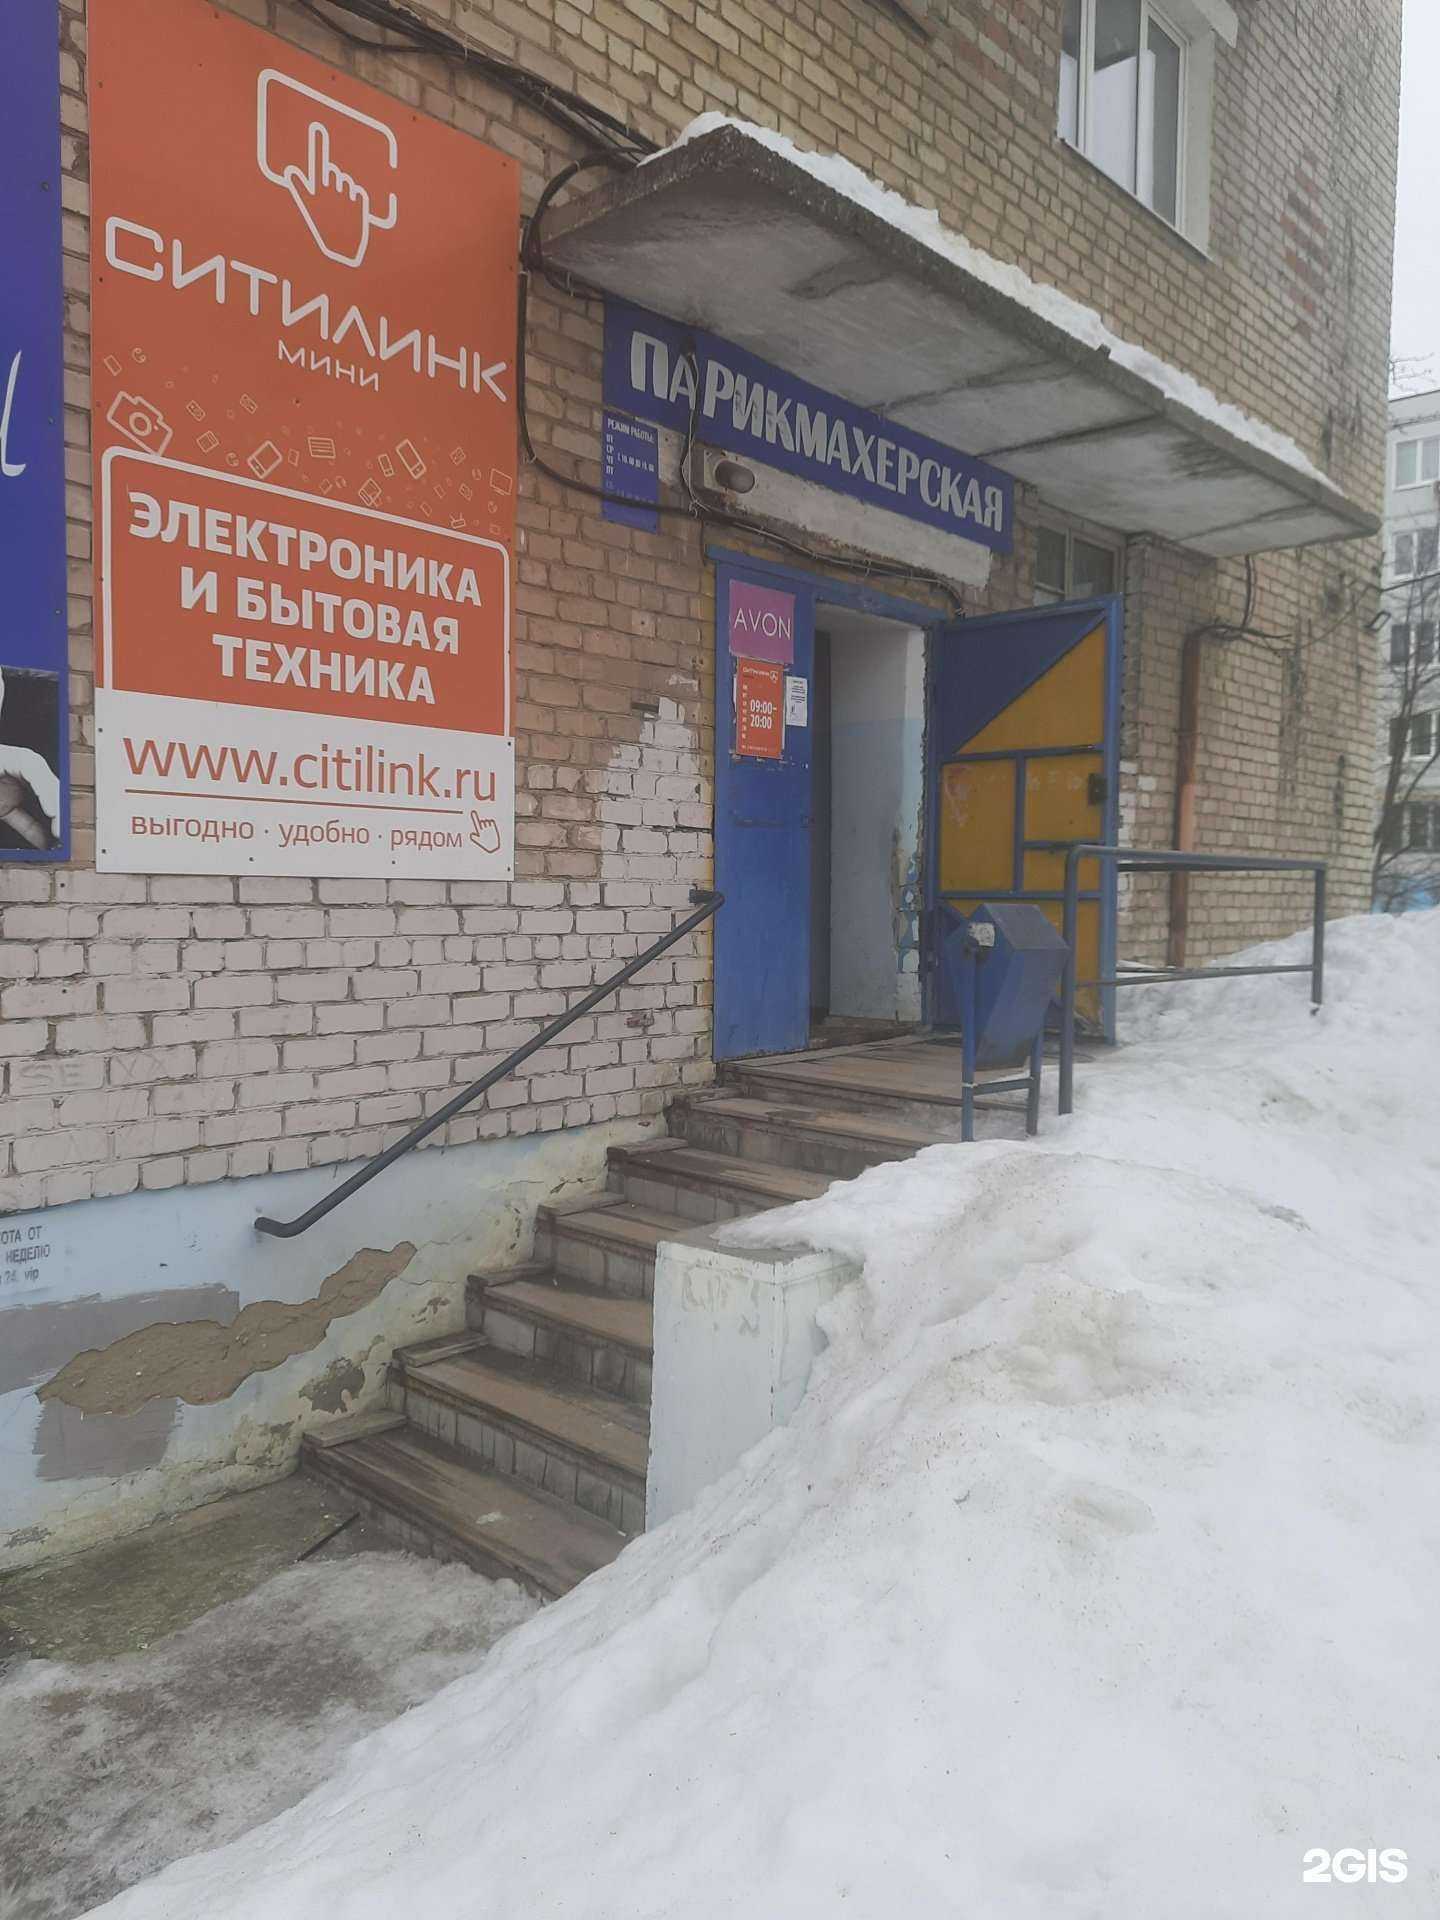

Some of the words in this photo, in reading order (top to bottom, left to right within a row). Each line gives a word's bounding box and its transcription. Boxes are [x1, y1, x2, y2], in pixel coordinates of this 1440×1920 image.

[105, 216, 508, 403] СИТИЛИНК
[629, 329, 1004, 533] ПАРИКМАХЕРСКАЯ
[128, 491, 482, 607] ЭЛЕКТРОНИКА
[180, 567, 218, 614] И
[236, 576, 459, 655] БЫТОВАЯ
[734, 608, 791, 640] AVON
[212, 633, 436, 705] ТЕХНИКА
[750, 714, 772, 729] 20:00
[123, 737, 496, 802] www.citilink.ru
[131, 816, 255, 843] выгодно
[279, 819, 371, 848] удобно
[390, 826, 464, 851] рядом
[0, 1229, 22, 1246] ОТА
[28, 1225, 42, 1241] ОТ
[6, 1244, 51, 1265] НЕДЕЛЮ
